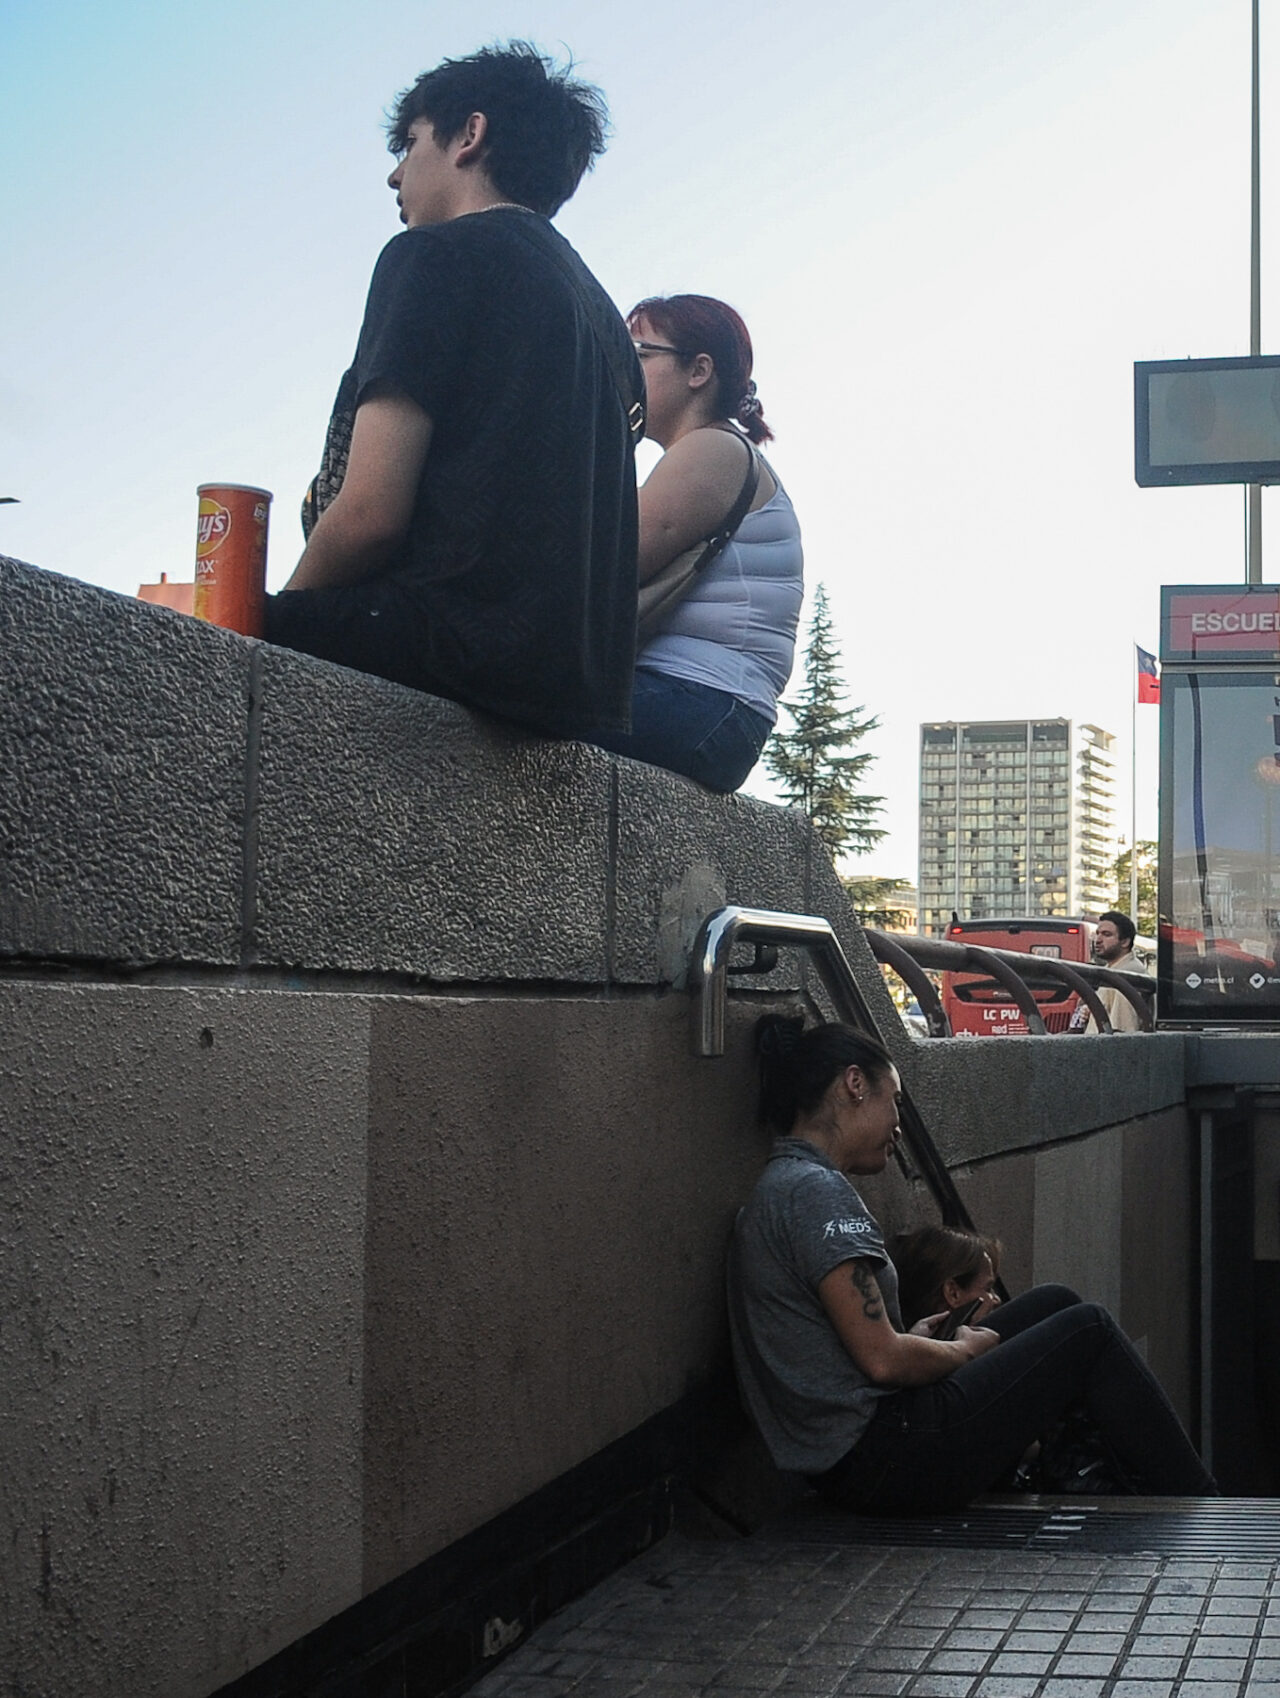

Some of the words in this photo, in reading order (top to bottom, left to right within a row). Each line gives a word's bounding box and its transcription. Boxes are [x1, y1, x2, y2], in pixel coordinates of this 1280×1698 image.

[983, 1009, 997, 1021] LC
[1000, 1009, 1020, 1021] PW
[838, 1221, 872, 1233] MEDS
